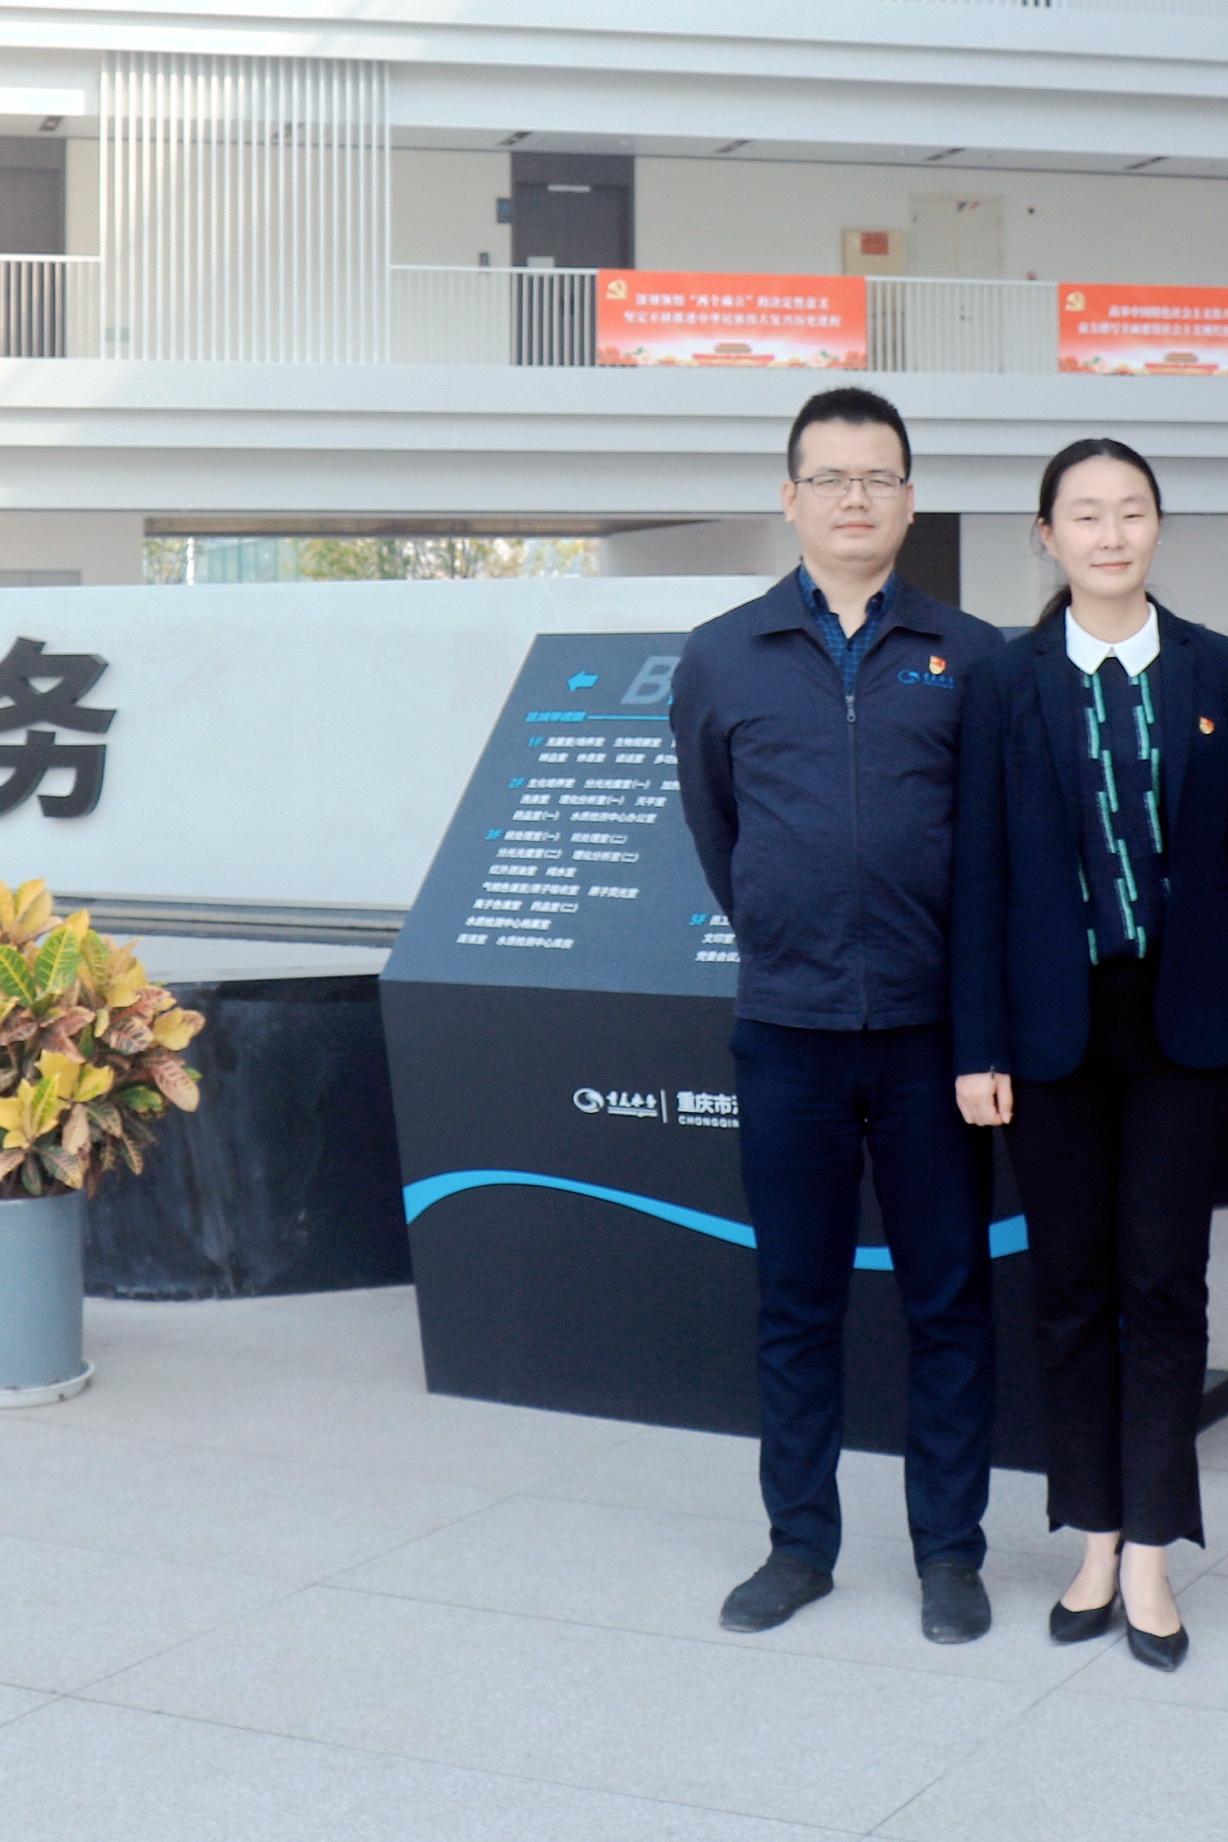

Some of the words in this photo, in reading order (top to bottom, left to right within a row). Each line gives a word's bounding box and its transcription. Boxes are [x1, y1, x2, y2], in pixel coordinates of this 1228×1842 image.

[621, 656, 680, 704] B
[0, 636, 117, 817] 务
[508, 777, 525, 788] 2F
[485, 829, 502, 841] 3F
[689, 914, 707, 926] 5F
